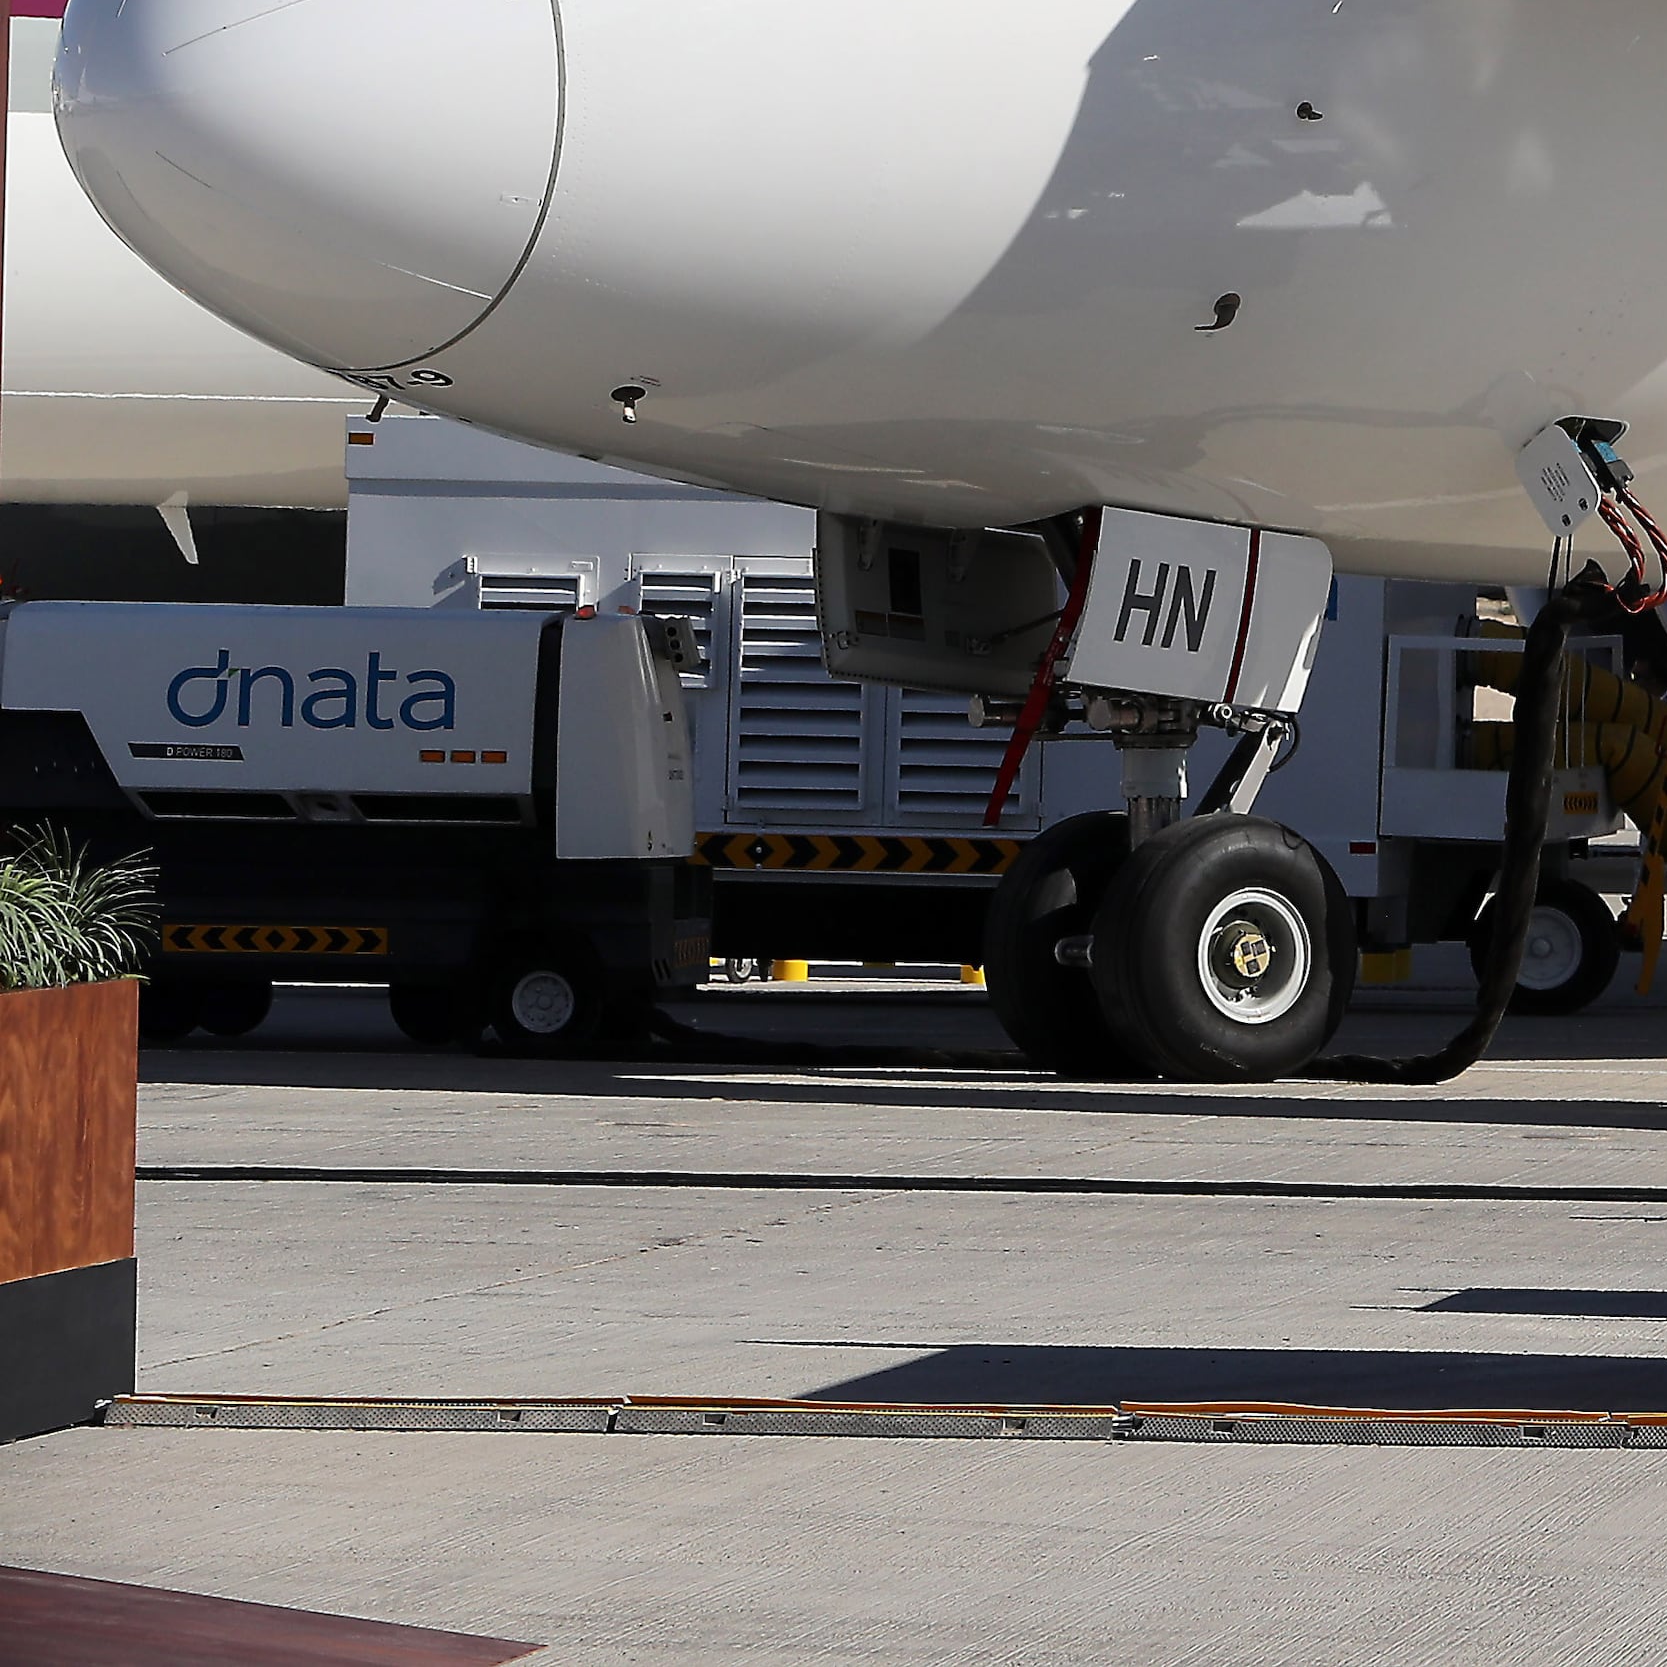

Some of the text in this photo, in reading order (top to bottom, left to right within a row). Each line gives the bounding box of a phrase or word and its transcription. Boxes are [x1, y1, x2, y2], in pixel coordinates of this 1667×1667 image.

[1113, 558, 1217, 653] HN
[166, 648, 456, 731] dnata
[176, 747, 214, 758] POWER
